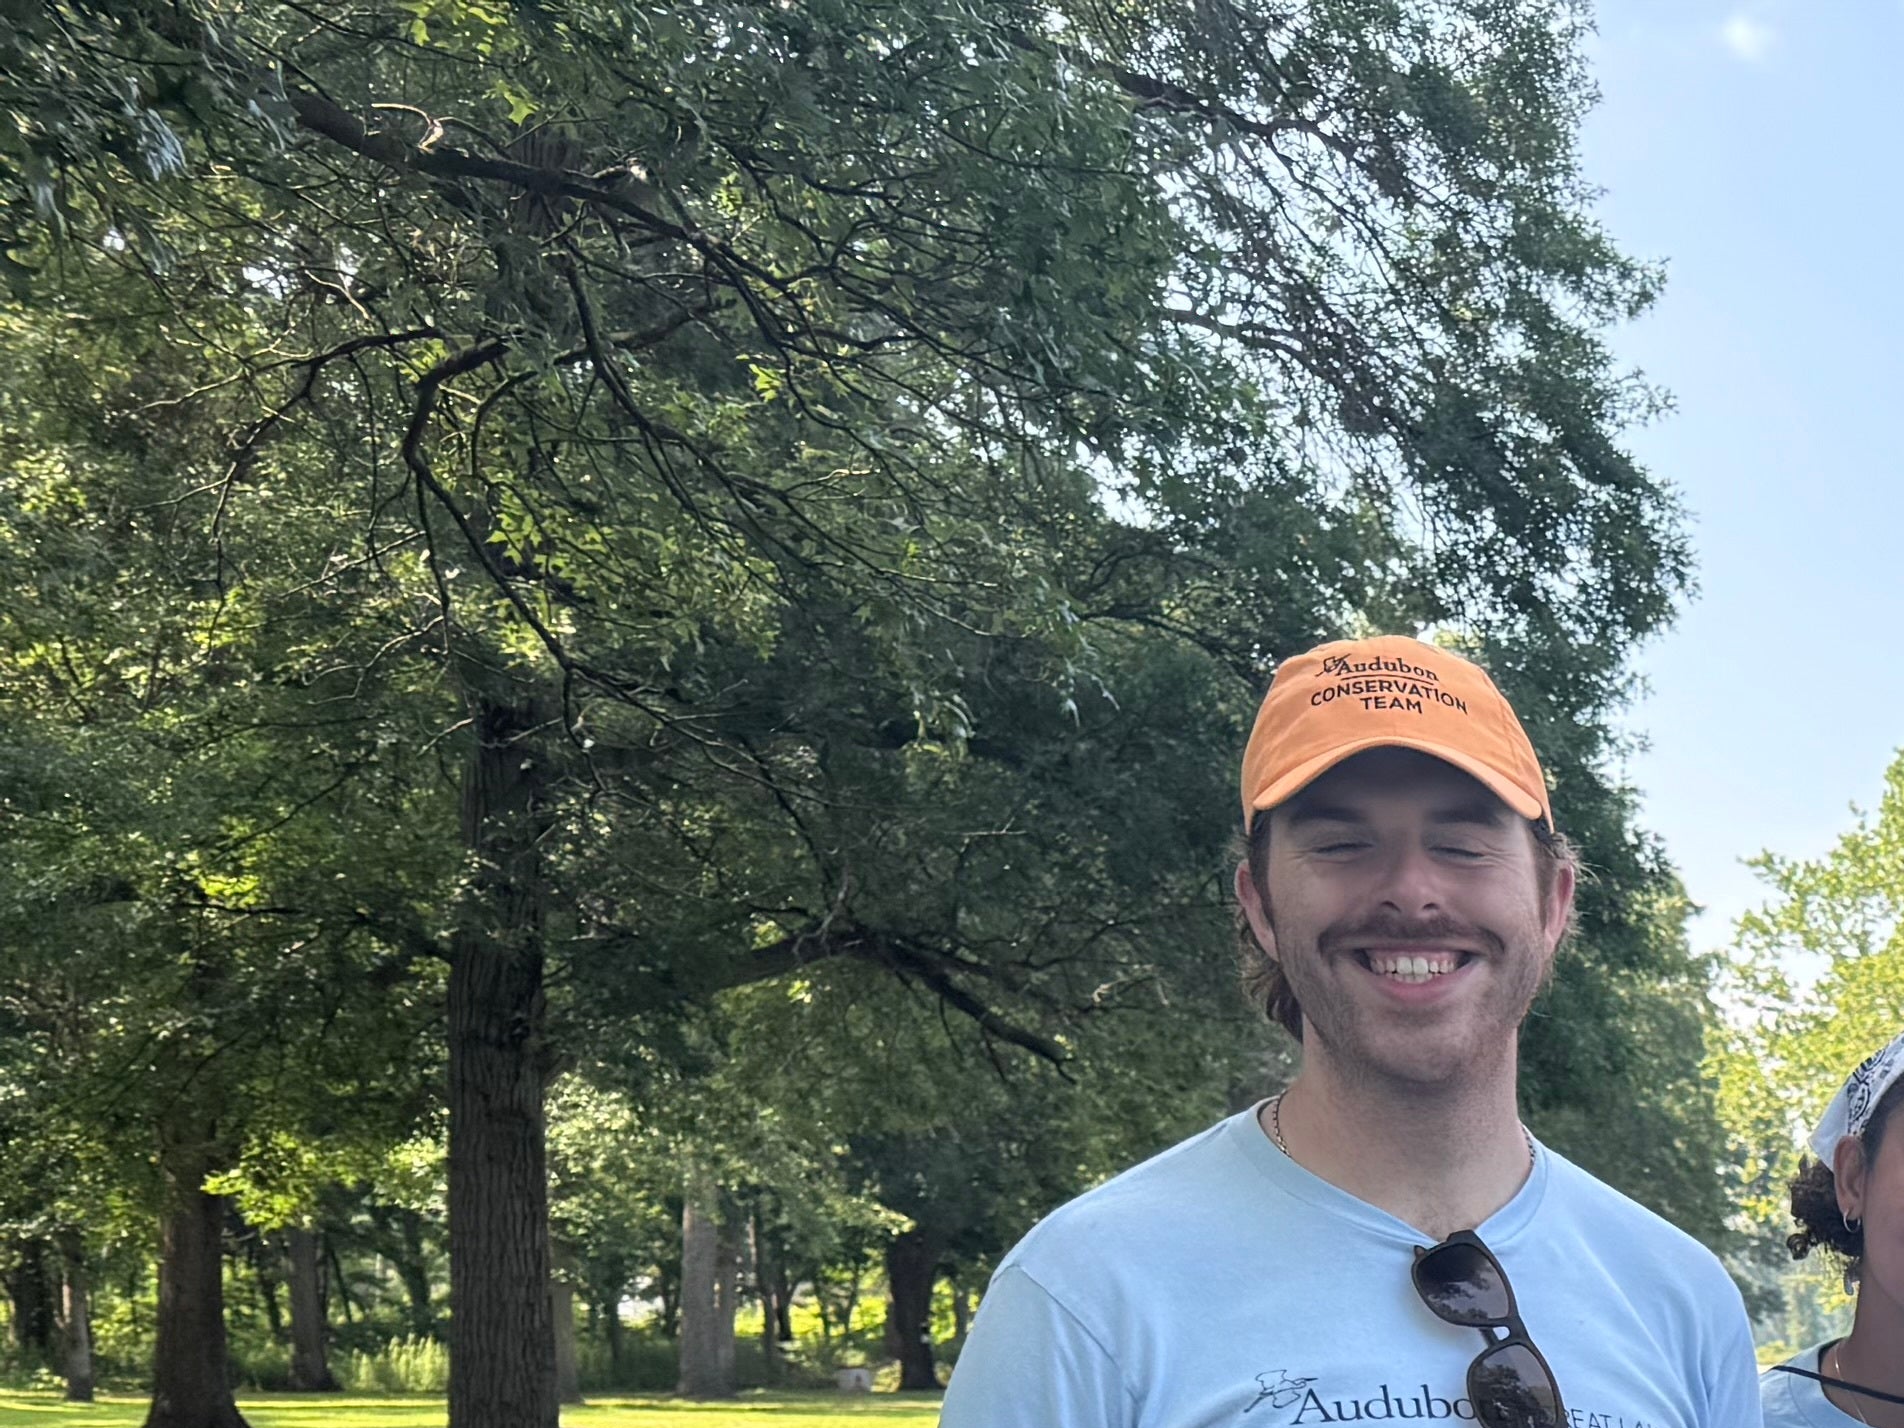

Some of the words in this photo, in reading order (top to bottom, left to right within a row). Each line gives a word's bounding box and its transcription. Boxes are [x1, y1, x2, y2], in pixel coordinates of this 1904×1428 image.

[1335, 656, 1439, 681] Audubon
[1311, 680, 1468, 715] CONSERVATION
[1360, 696, 1422, 714] TEAM
[1290, 1384, 1478, 1425] Audubo
